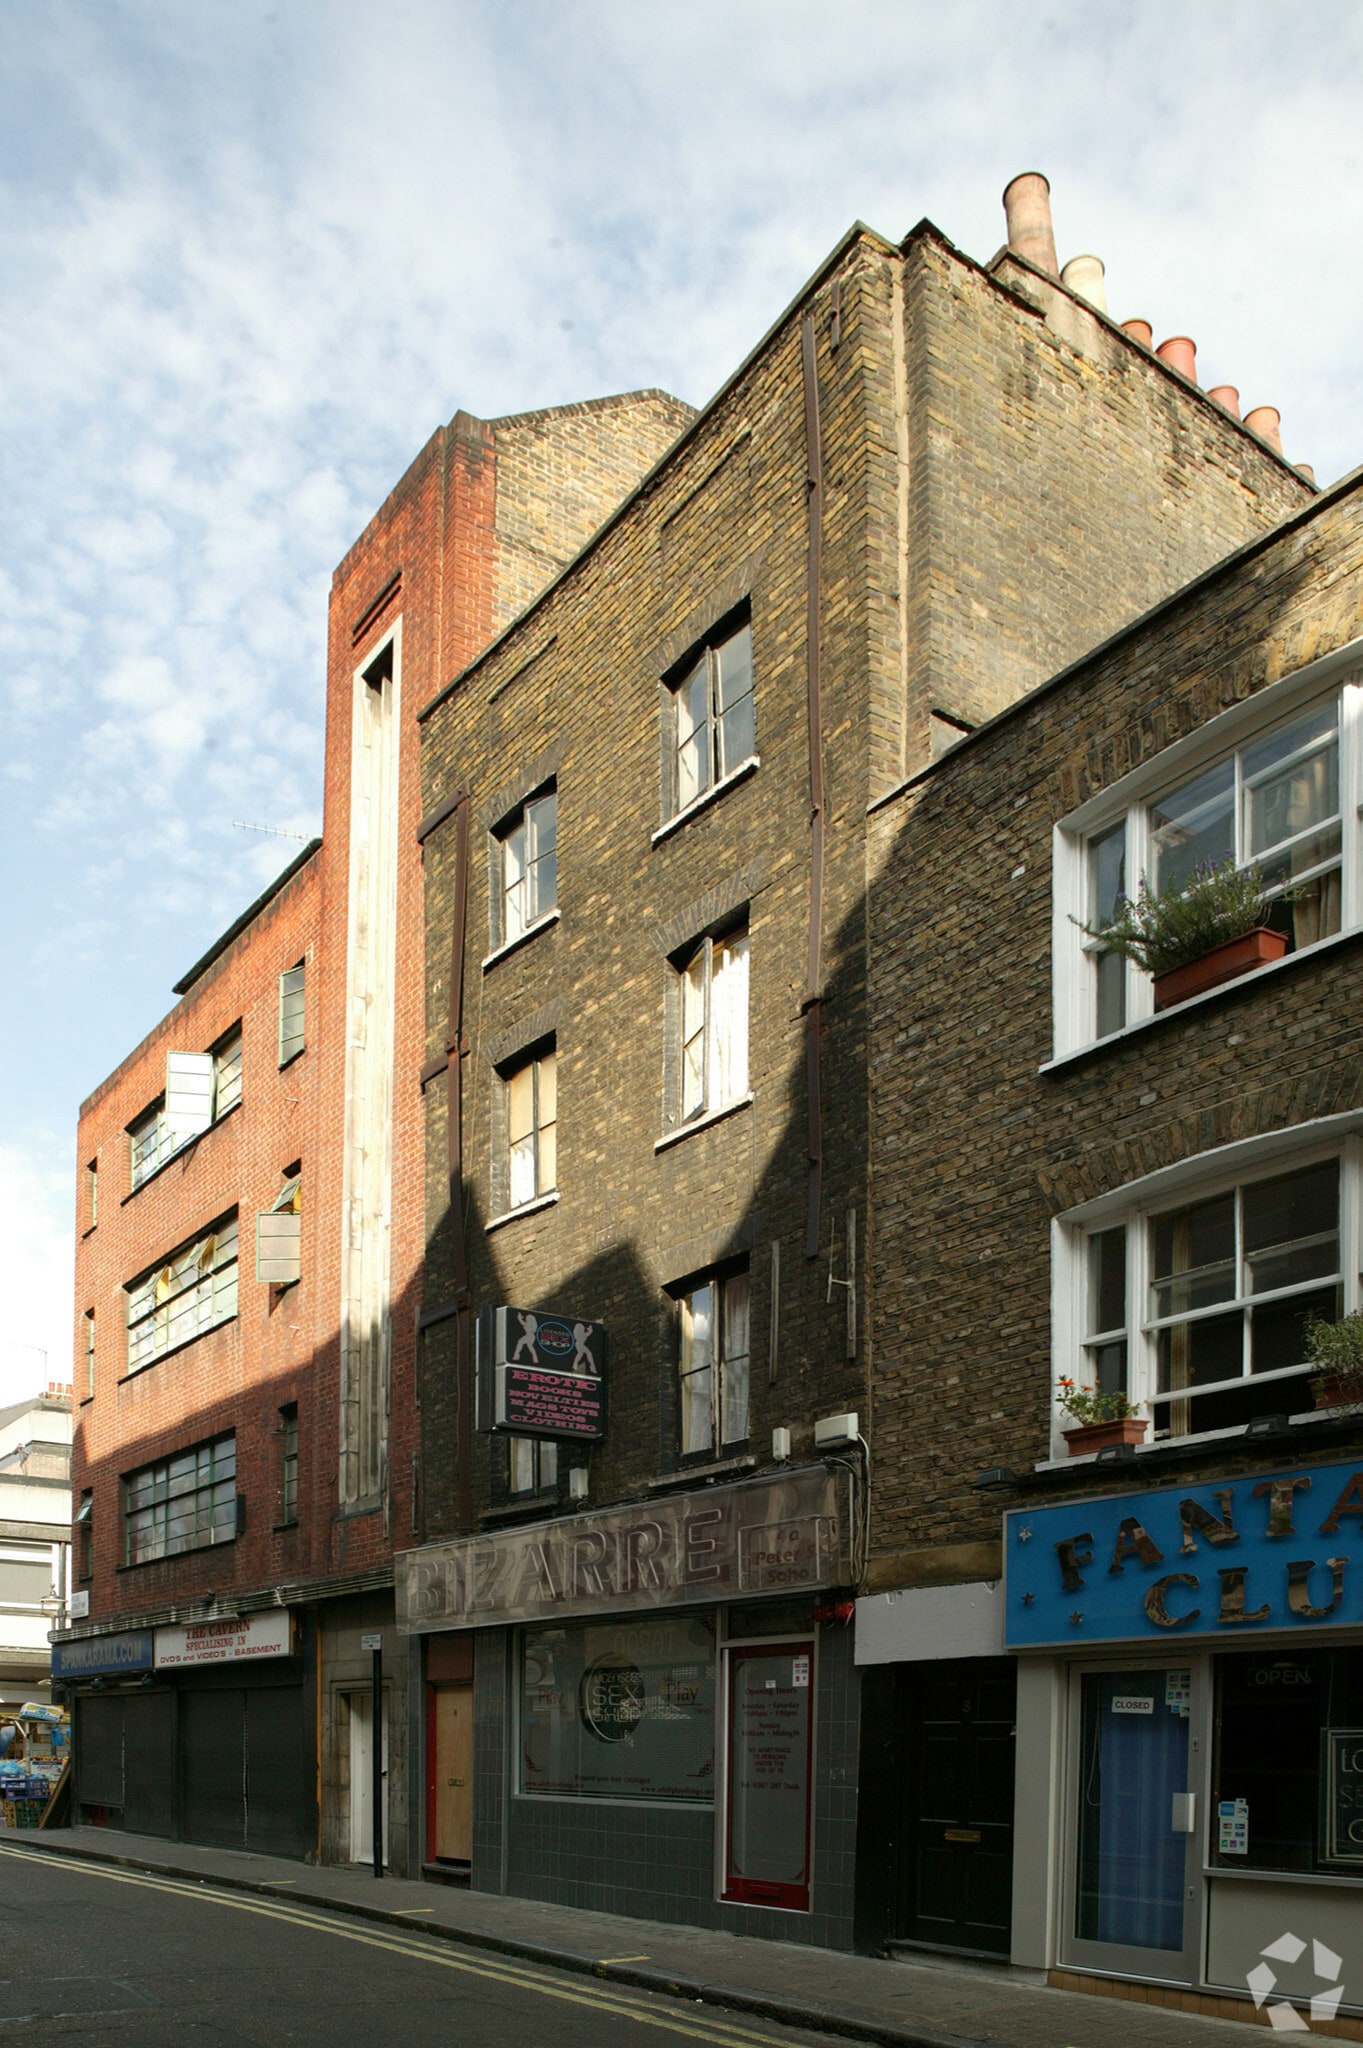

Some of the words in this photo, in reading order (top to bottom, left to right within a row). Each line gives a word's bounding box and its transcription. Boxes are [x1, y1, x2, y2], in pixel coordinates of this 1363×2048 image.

[541, 1332, 568, 1342] SEX
[541, 1340, 570, 1348] SHOP
[512, 1370, 597, 1391] EROTIC
[508, 1389, 600, 1409] NOVELTIES
[528, 1384, 582, 1398] BOOKS
[524, 1408, 586, 1423] VIDEOS
[560, 1405, 599, 1417] TOYS
[510, 1414, 597, 1432] CLOTHING
[407, 1509, 722, 1619] BIZARRE
[756, 1549, 800, 1565] Peter
[768, 1567, 809, 1583] Soho
[186, 1637, 233, 1651] SPECIALISING
[238, 1636, 247, 1645] IN
[235, 1644, 282, 1655] BASEMENT
[1254, 1668, 1312, 1684] OPEN
[592, 1685, 639, 1706] SEX
[1115, 1701, 1150, 1709] CLOSED
[592, 1707, 642, 1723] SHOP
